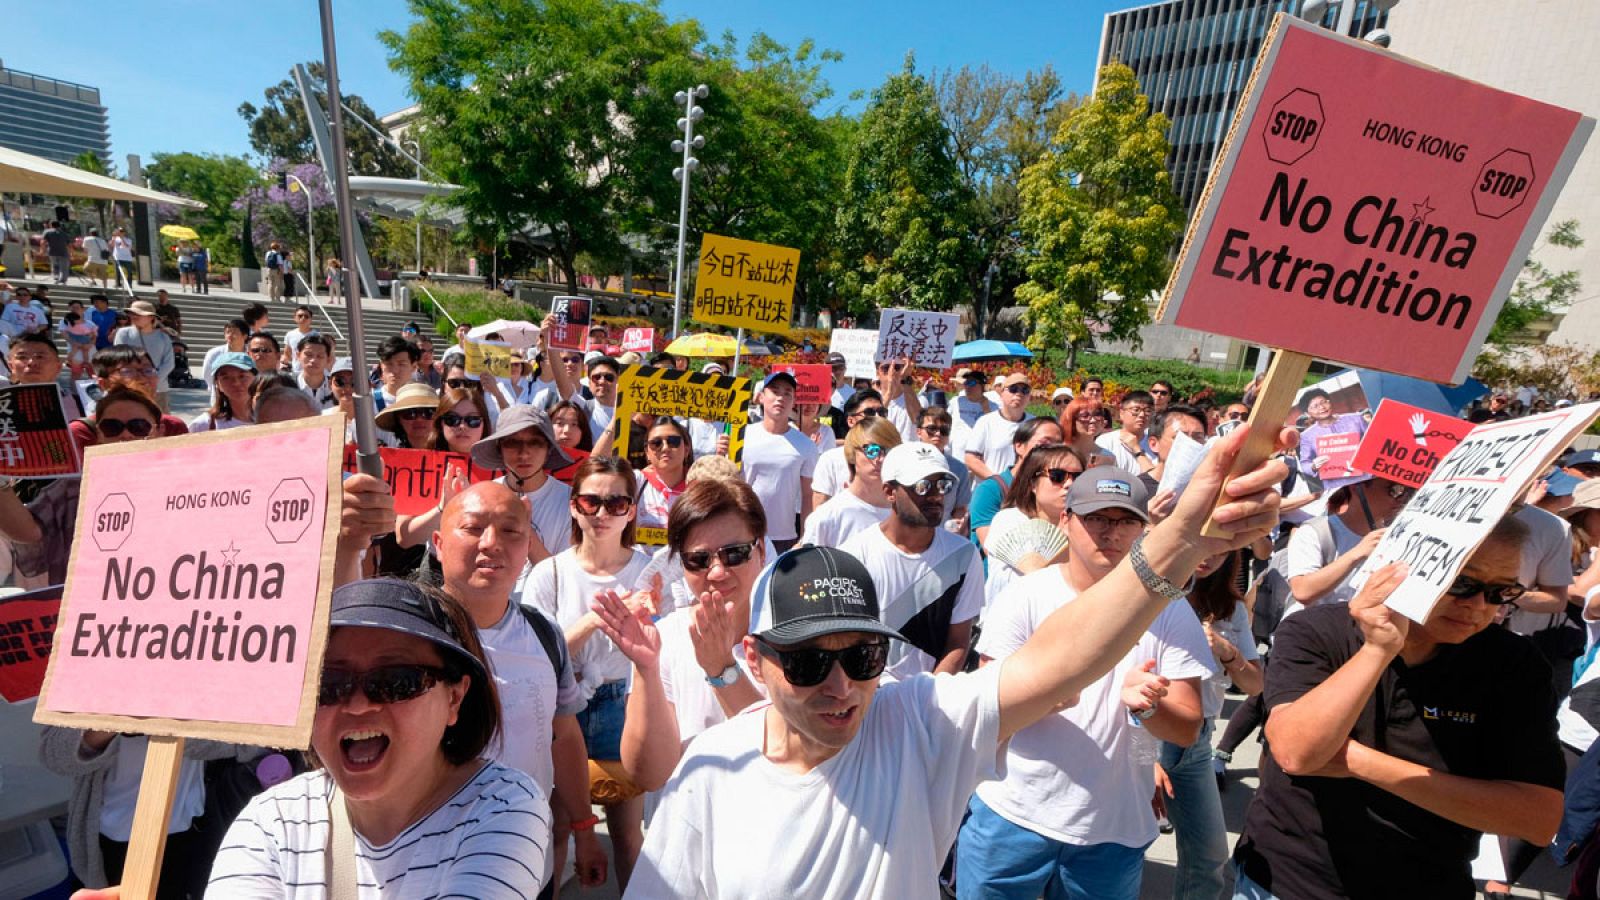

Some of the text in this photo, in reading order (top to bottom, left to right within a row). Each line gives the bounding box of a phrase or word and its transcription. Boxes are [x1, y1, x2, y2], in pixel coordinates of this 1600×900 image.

[1271, 110, 1317, 144] STOP
[1362, 119, 1468, 163] HONG KONG
[1480, 168, 1527, 199] STOP
[1260, 172, 1478, 269] No China
[702, 246, 793, 286] 今日不站出來
[1212, 228, 1473, 330] Extradition
[696, 287, 788, 324] 明日站不出來
[886, 313, 949, 342] 反送中
[1380, 438, 1408, 461] No
[1372, 457, 1431, 485] Extradi
[166, 489, 252, 511] HONG KONG
[271, 499, 309, 523] STOP
[1422, 483, 1499, 523] JUDICIAL
[97, 510, 131, 533] STOP
[102, 551, 285, 601] No China
[829, 587, 864, 598] COAST
[71, 610, 298, 664] Extradition
